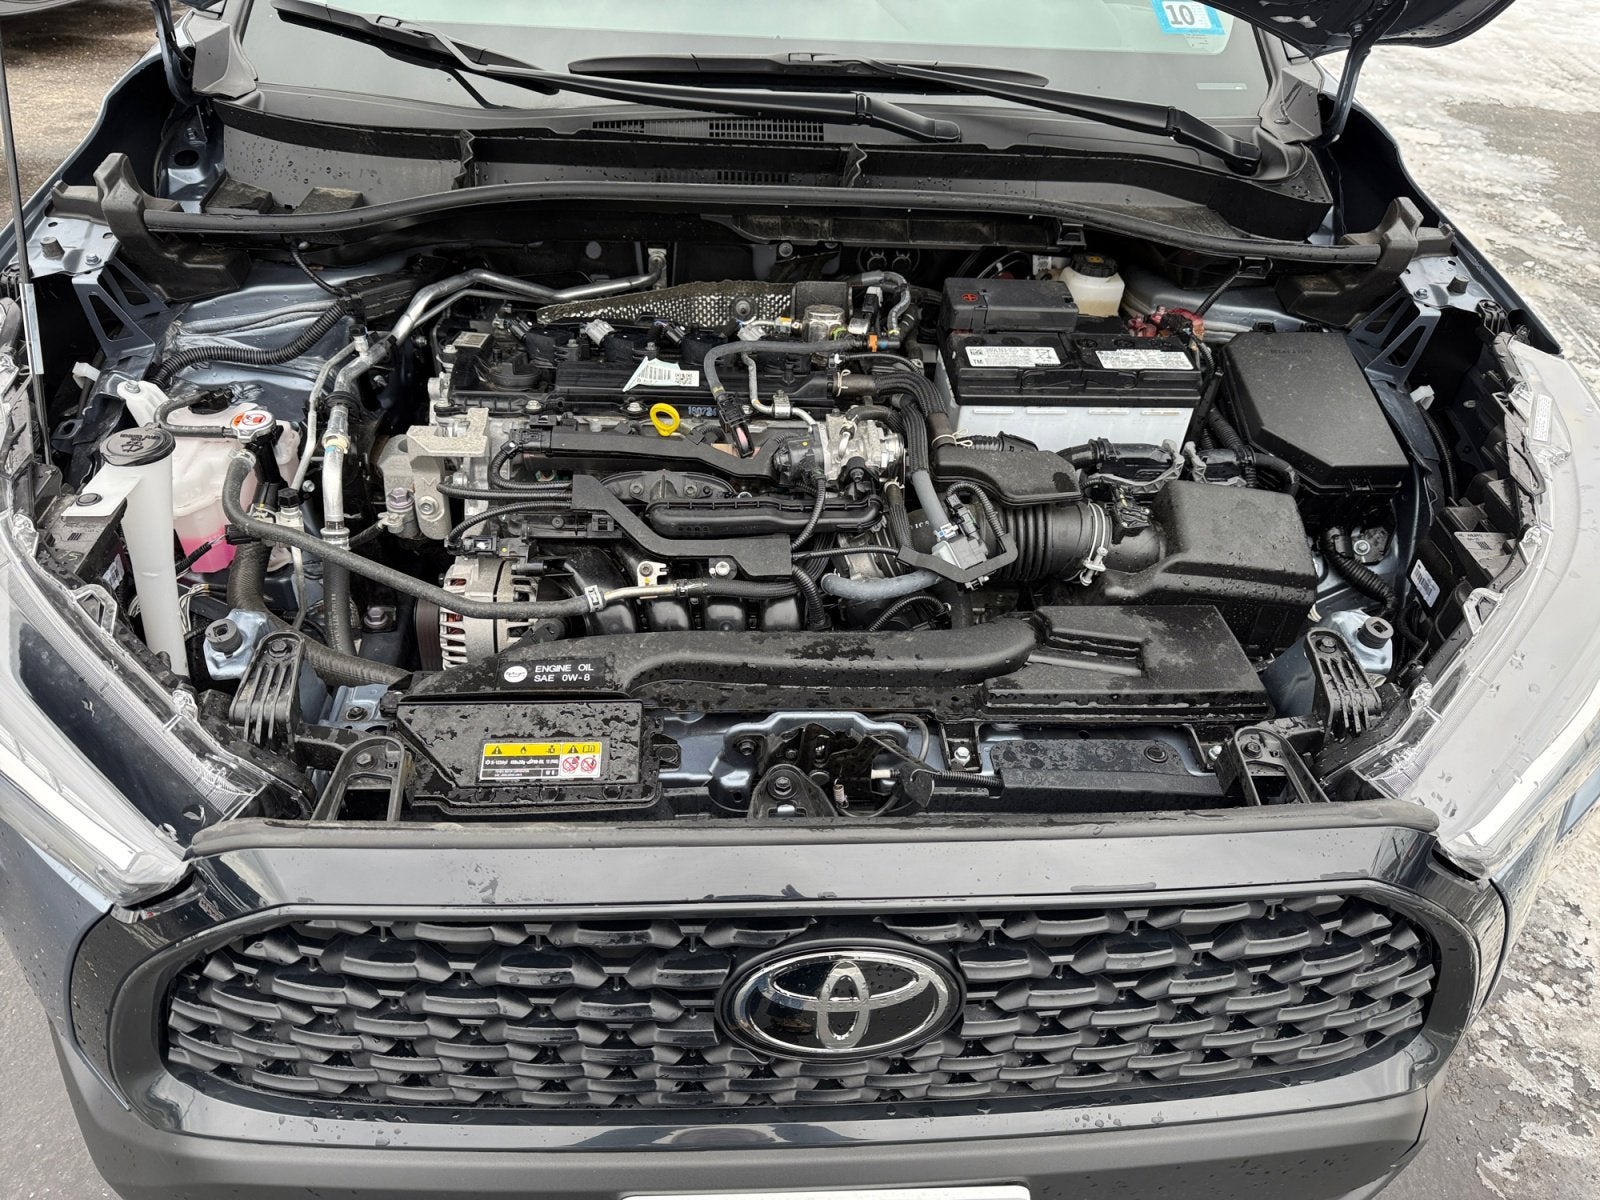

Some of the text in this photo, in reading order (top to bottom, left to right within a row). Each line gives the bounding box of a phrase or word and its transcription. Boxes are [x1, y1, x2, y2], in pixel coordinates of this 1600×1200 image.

[1165, 4, 1195, 26] 10
[535, 663, 594, 673] ENGINE OIL
[533, 673, 591, 682] SAE 0W-8
